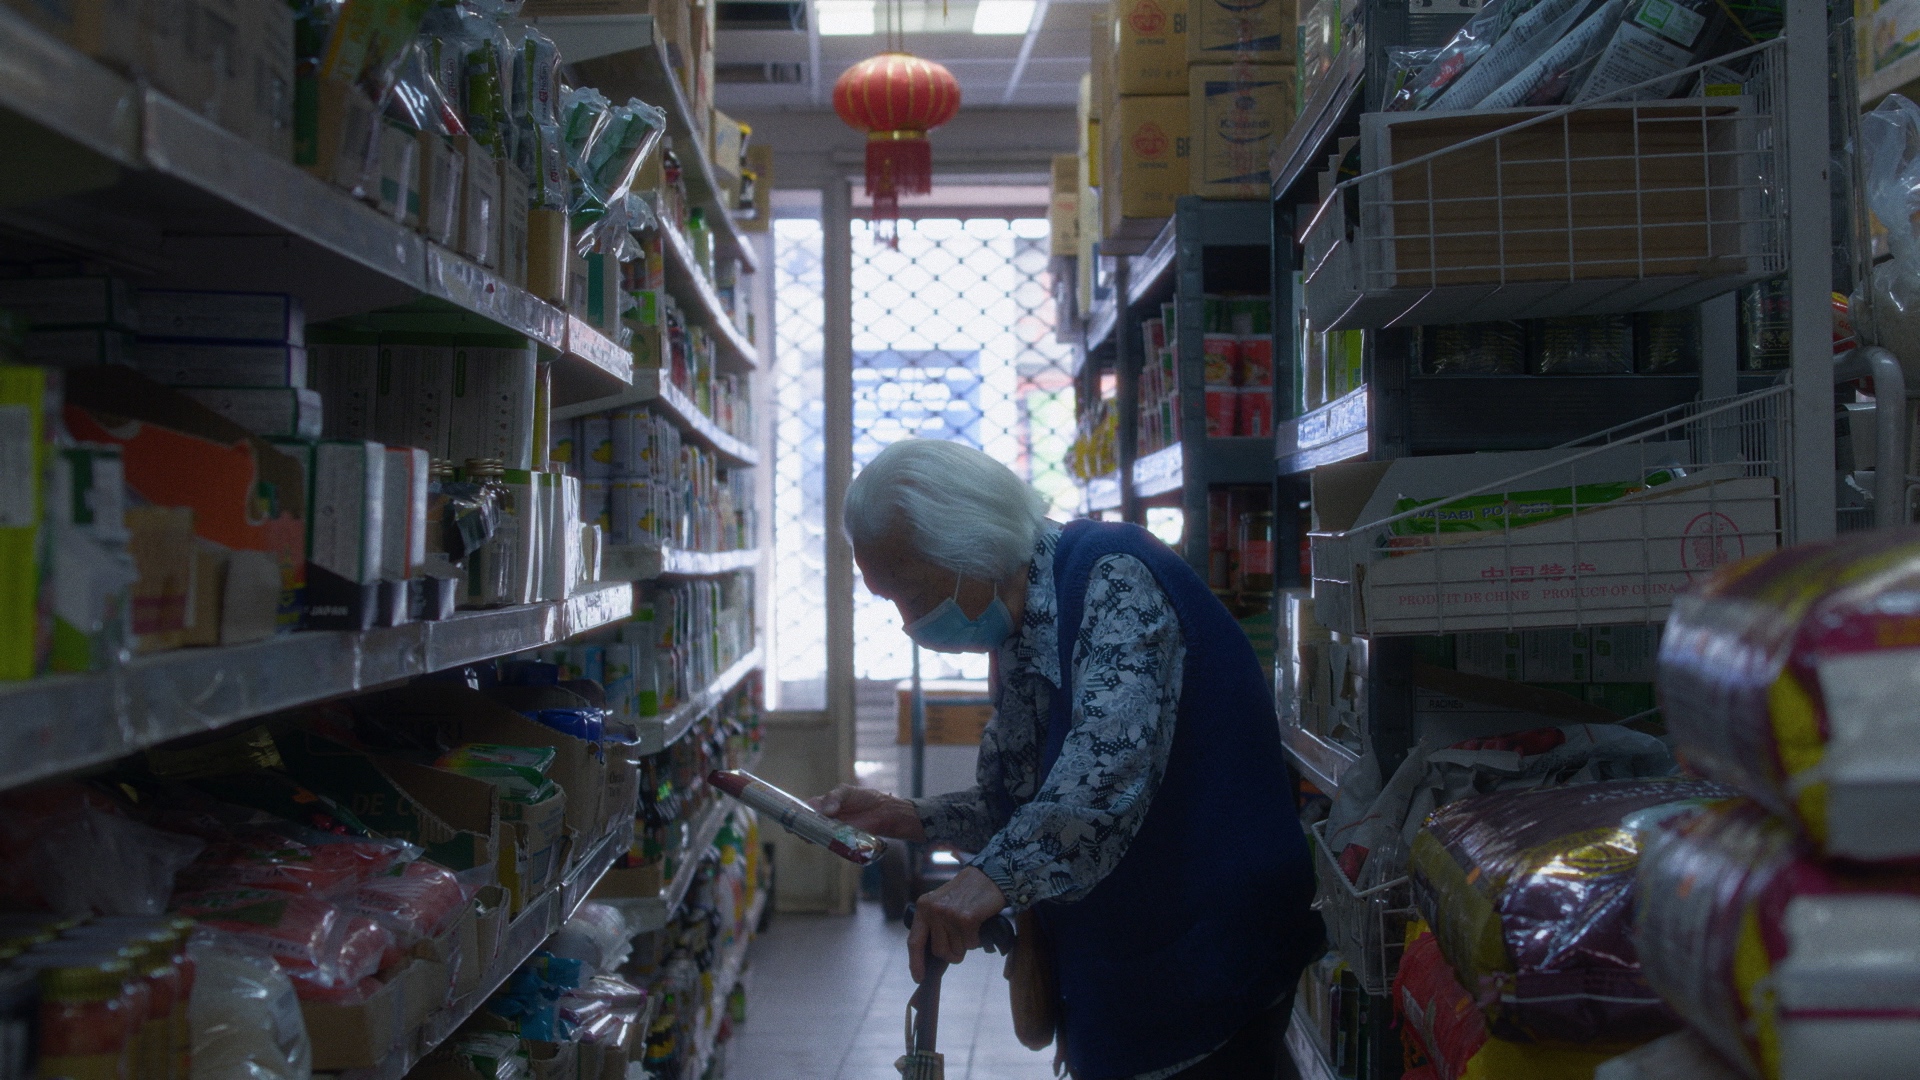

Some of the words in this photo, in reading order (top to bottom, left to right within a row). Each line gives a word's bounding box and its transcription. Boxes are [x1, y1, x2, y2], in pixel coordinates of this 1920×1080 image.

[1413, 509, 1475, 521] WASABI
[1482, 501, 1553, 518] PODER
[1398, 592, 1461, 606] PRODUIT
[1463, 591, 1483, 604] DE
[1485, 589, 1529, 603] CHINE
[1542, 585, 1611, 600] PRODUCT
[1612, 584, 1631, 597] OF
[1632, 582, 1676, 596] CHINA
